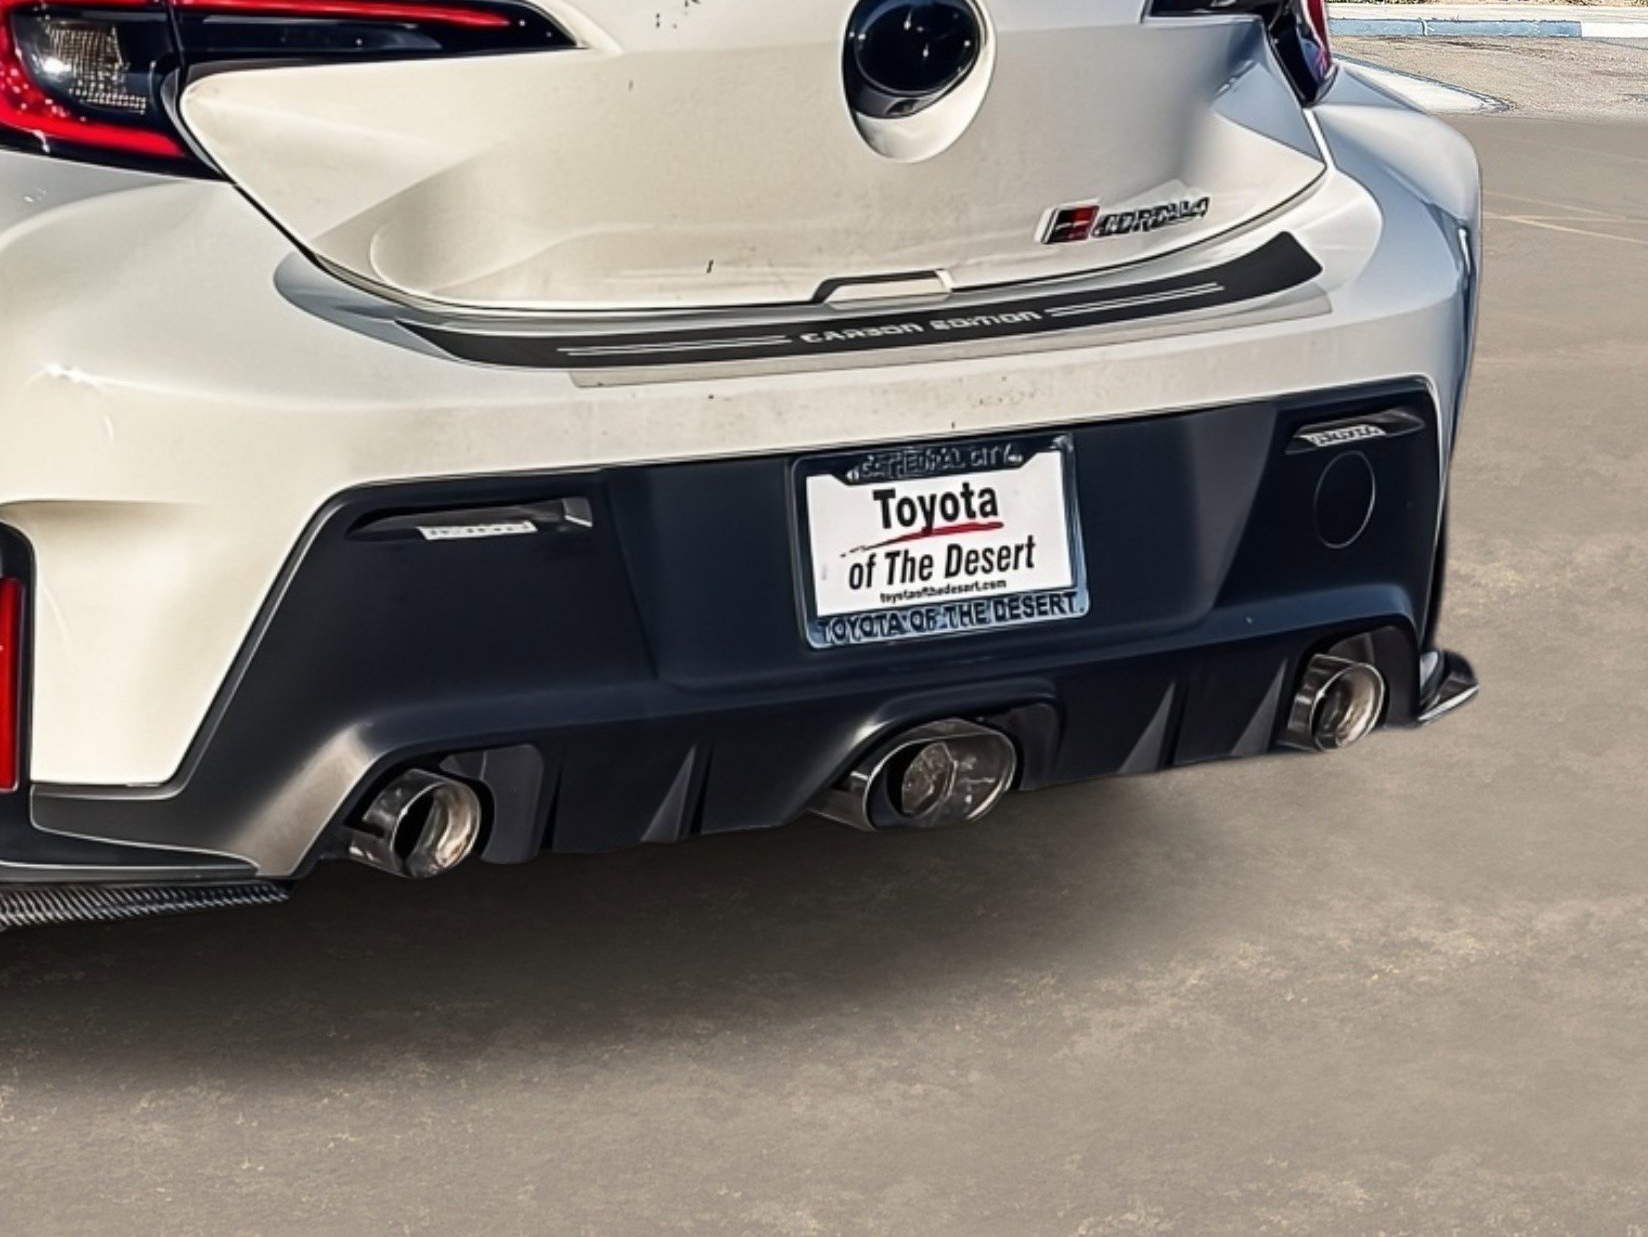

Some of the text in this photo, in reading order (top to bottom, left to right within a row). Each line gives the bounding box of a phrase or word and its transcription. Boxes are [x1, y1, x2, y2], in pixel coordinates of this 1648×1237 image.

[799, 311, 1042, 344] CARBON EDITION
[873, 482, 999, 533] Toyota
[848, 535, 1036, 590] of The Desert
[880, 578, 1007, 604] toyotaofthedesert.com
[818, 591, 1078, 643] TOYOTA OF THE DESERT
